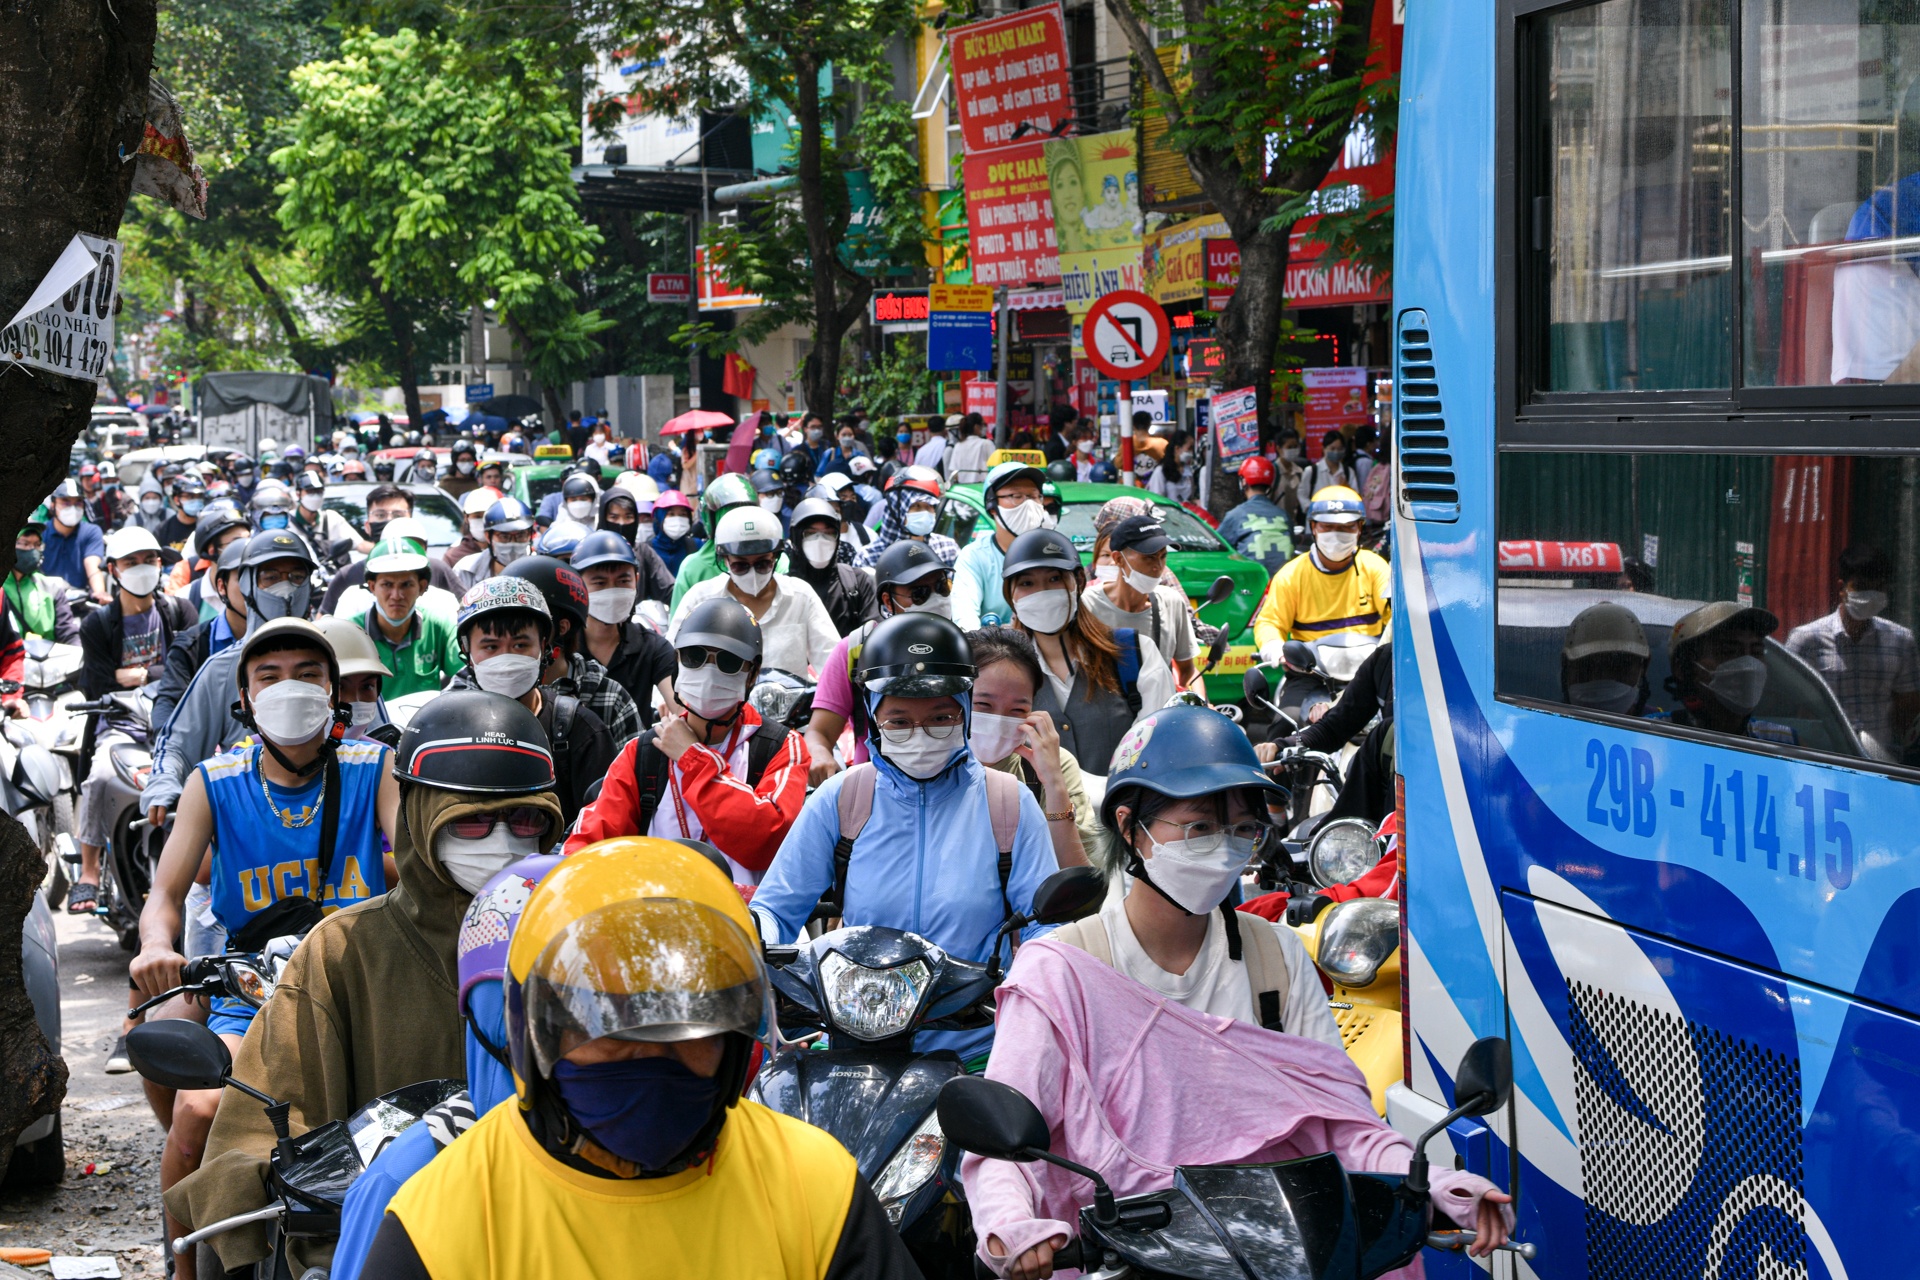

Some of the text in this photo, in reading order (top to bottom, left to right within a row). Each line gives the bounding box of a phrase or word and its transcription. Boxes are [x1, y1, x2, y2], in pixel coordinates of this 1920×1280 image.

[964, 21, 1046, 60] ĐỨC HẠNH MART
[988, 160, 1015, 184] ĐỨC
[978, 233, 1006, 256] PHOTO
[1011, 231, 1024, 252] IN
[656, 279, 685, 291] ATM
[1062, 265, 1091, 306] HIỆU
[36, 311, 61, 328] CAO
[43, 328, 74, 369] 404
[78, 336, 108, 375] 473
[1327, 501, 1344, 510] be
[477, 595, 519, 610] amazon
[498, 738, 515, 746] LỰC
[1586, 738, 1658, 839] 29B
[1700, 763, 1854, 891] 414.15
[238, 855, 371, 913] UCLA
[827, 1071, 869, 1079] HONDA
